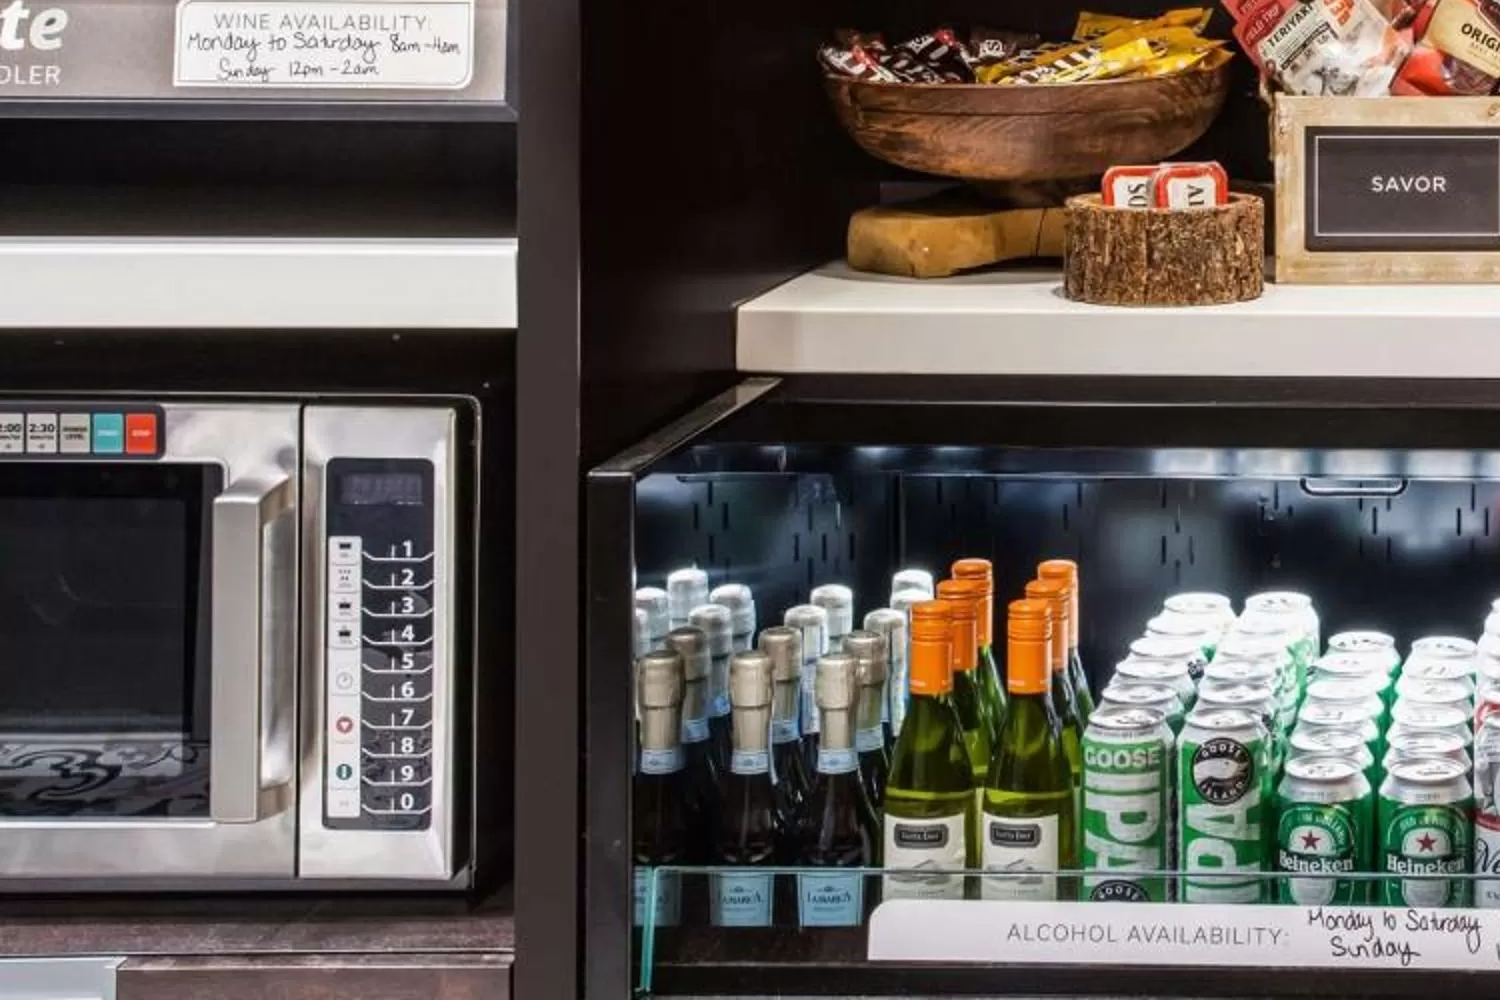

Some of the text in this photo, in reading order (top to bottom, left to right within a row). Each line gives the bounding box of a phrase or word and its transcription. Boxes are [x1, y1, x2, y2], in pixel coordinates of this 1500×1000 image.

[213, 13, 271, 31] WINE
[1267, 3, 1315, 48] TERIYAKI
[187, 32, 262, 62] Monday
[268, 31, 287, 51] to
[391, 33, 421, 54] 8am
[217, 56, 277, 83] Sunday
[289, 60, 324, 78] 12pm
[1371, 175, 1447, 192] SAVOR
[402, 541, 414, 557] 1
[402, 569, 414, 585] 2
[402, 597, 414, 613] 3
[402, 625, 414, 641] 4
[402, 653, 414, 670] 5
[402, 682, 414, 698] 6
[402, 710, 414, 726] 7
[402, 737, 414, 753] 8
[1085, 747, 1161, 768] GOOSE
[402, 765, 414, 781] 9
[402, 793, 414, 809] 0
[1279, 849, 1354, 873] Heineken
[1387, 853, 1466, 876] Heineken
[1007, 922, 1290, 945] ALCOHOL AVAILABILITY:
[1308, 908, 1375, 943] Monday
[1382, 910, 1397, 931] to
[1331, 937, 1422, 967] Sunday
